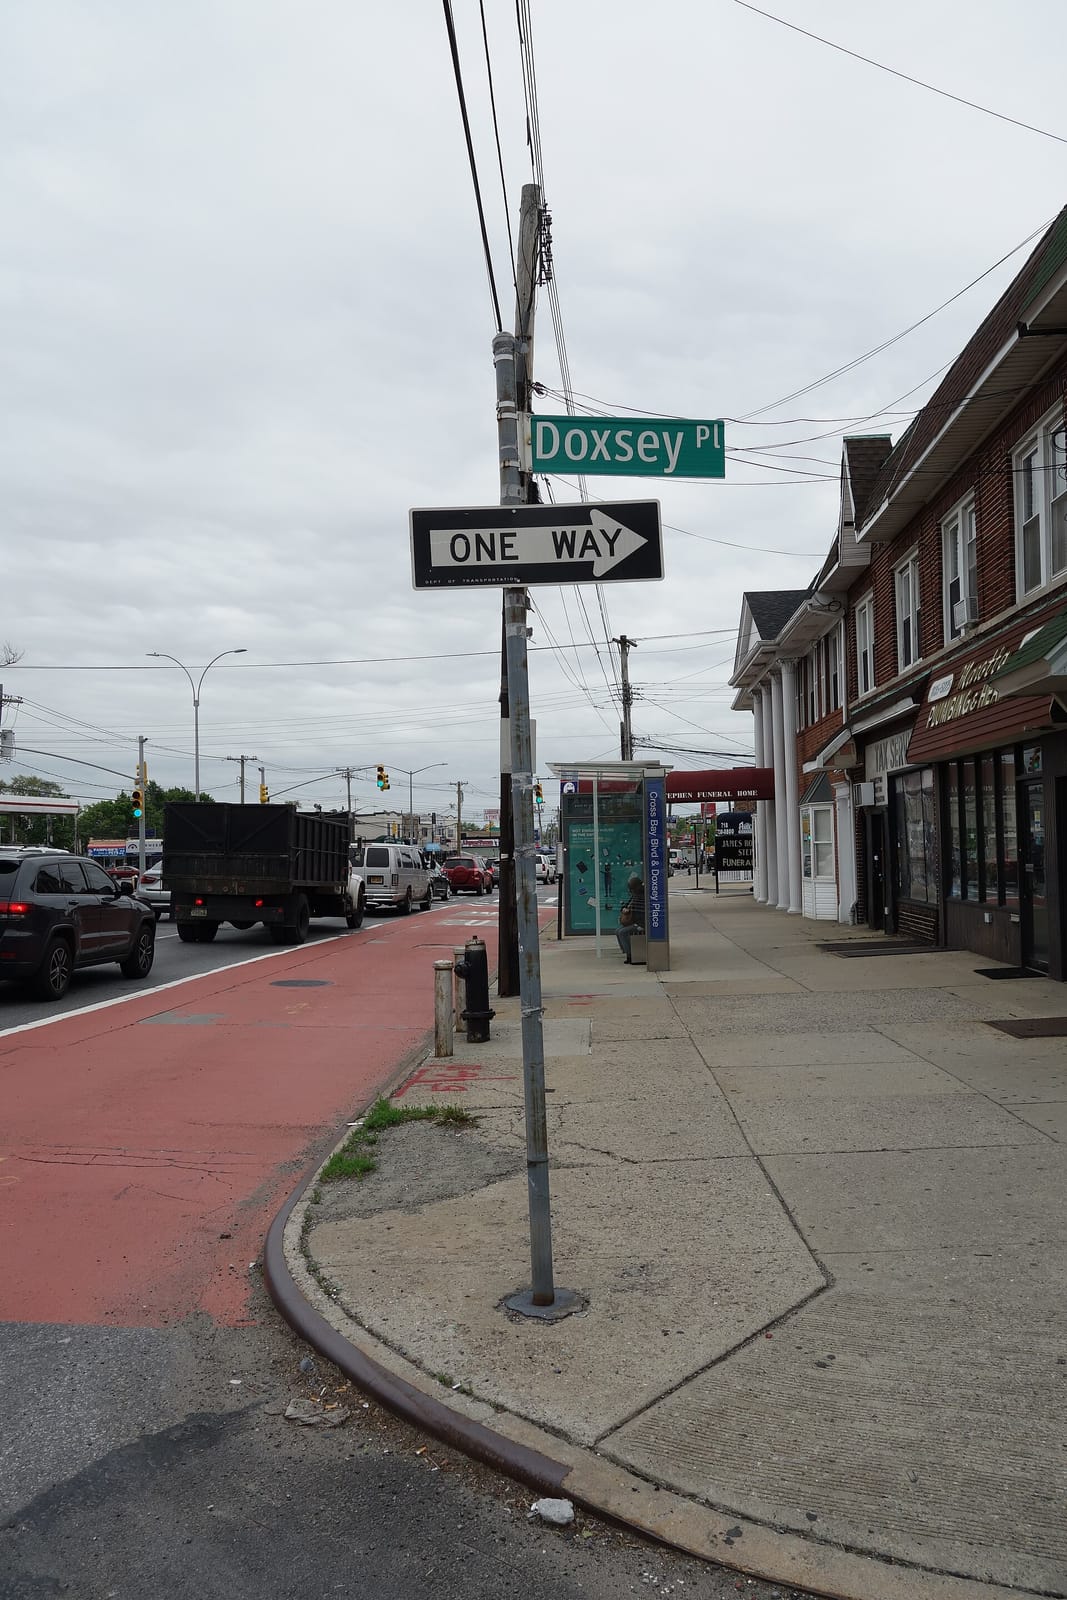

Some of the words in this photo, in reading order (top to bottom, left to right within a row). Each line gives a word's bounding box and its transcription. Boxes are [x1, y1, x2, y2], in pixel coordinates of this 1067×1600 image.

[535, 421, 684, 474] Doxsey
[695, 424, 721, 450] Pl
[449, 531, 519, 563] ONE
[551, 527, 623, 560] WAY
[874, 741, 889, 773] TAX
[649, 791, 658, 817] Cross
[697, 790, 733, 800] FUNERAL
[737, 789, 759, 798] HOME
[649, 819, 659, 837] Bay
[650, 838, 659, 858] Blvd
[722, 839, 743, 848] JAMES
[650, 869, 660, 902] Doxsey
[652, 903, 661, 928] Place
